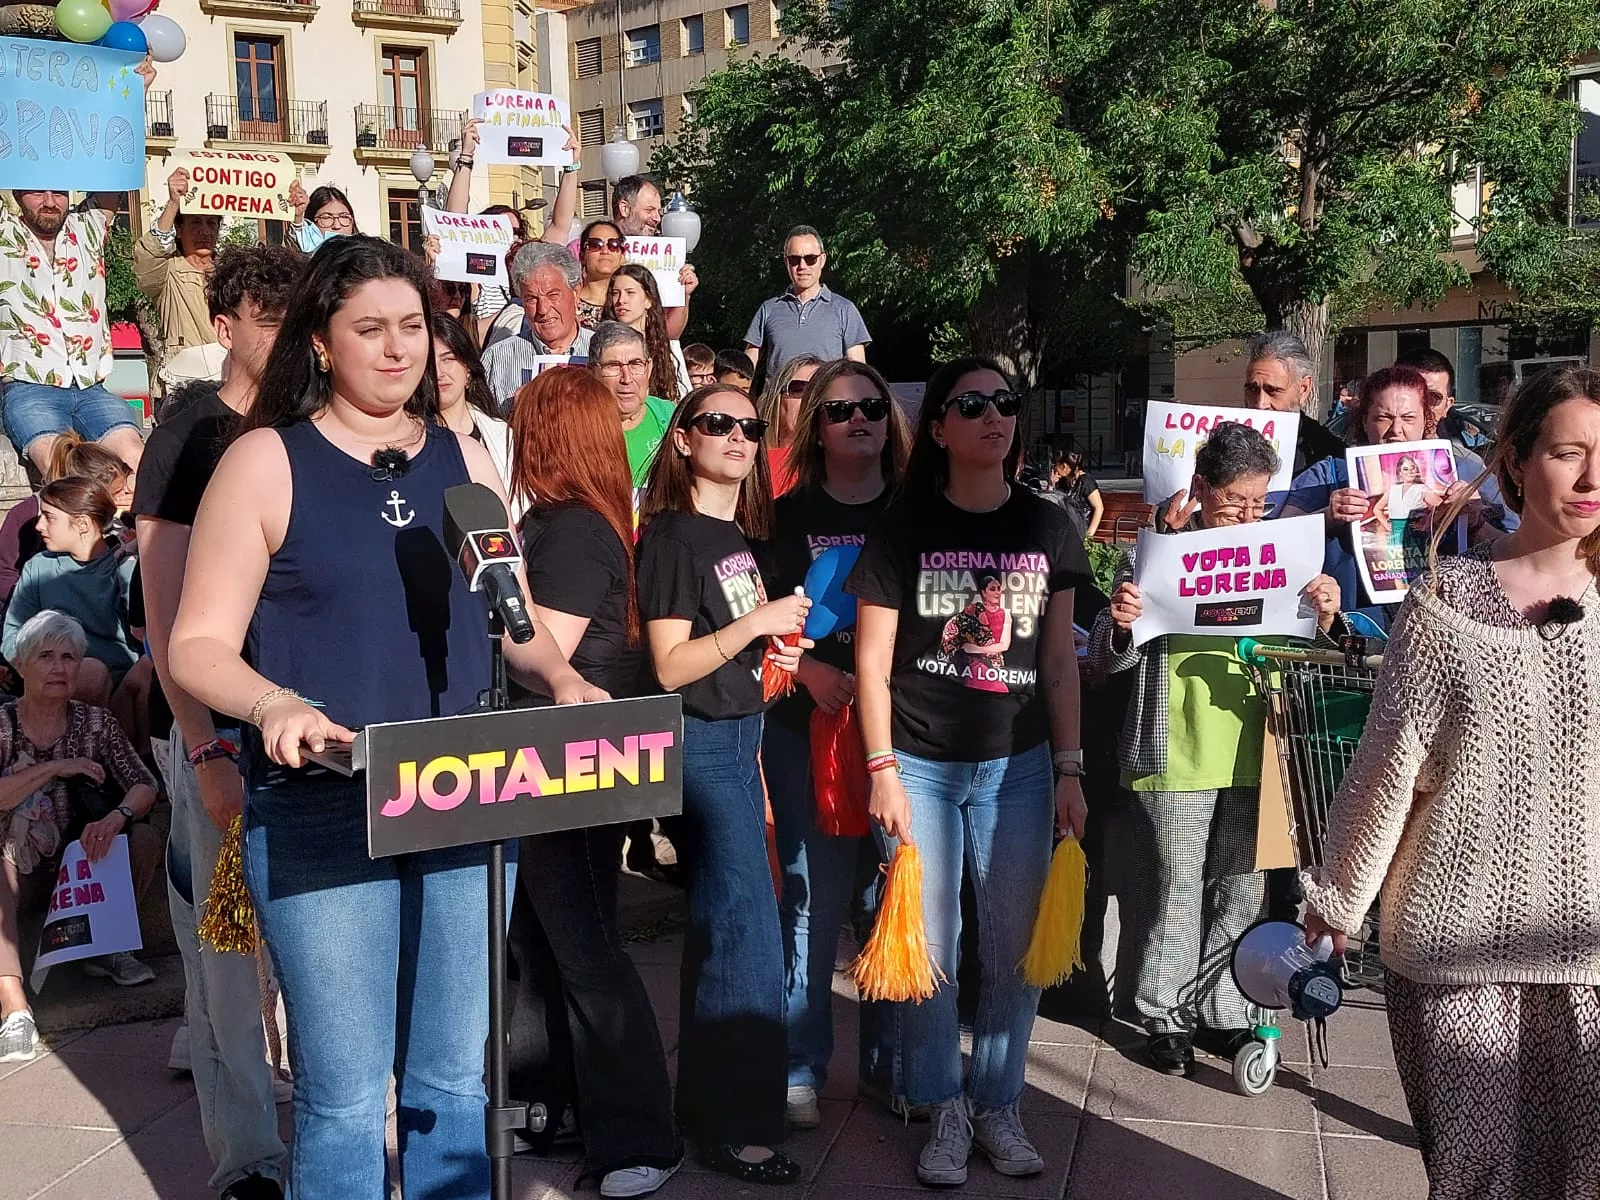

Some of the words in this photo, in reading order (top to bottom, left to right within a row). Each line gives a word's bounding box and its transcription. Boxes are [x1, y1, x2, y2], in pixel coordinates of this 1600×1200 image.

[485, 93, 543, 111] LORENA
[548, 99, 557, 111] A
[189, 151, 281, 163] ESTAMOS
[192, 166, 277, 189] CONTIGO
[200, 193, 274, 214] LORENA
[434, 214, 490, 229] LORENA
[493, 219, 502, 230] A
[623, 241, 659, 256] RENA
[665, 243, 672, 256] A
[1261, 420, 1276, 439] A
[1156, 436, 1185, 458] LA
[920, 552, 997, 569] LORENA
[1001, 552, 1050, 573] MATA
[1181, 545, 1252, 573] VOTA
[1259, 542, 1277, 565] A
[919, 571, 978, 592] FINA
[1178, 568, 1288, 597] LORENA
[1017, 616, 1034, 637] 3
[917, 657, 959, 677] VOTA
[961, 665, 974, 678] A
[380, 731, 674, 817] JOTALENT
